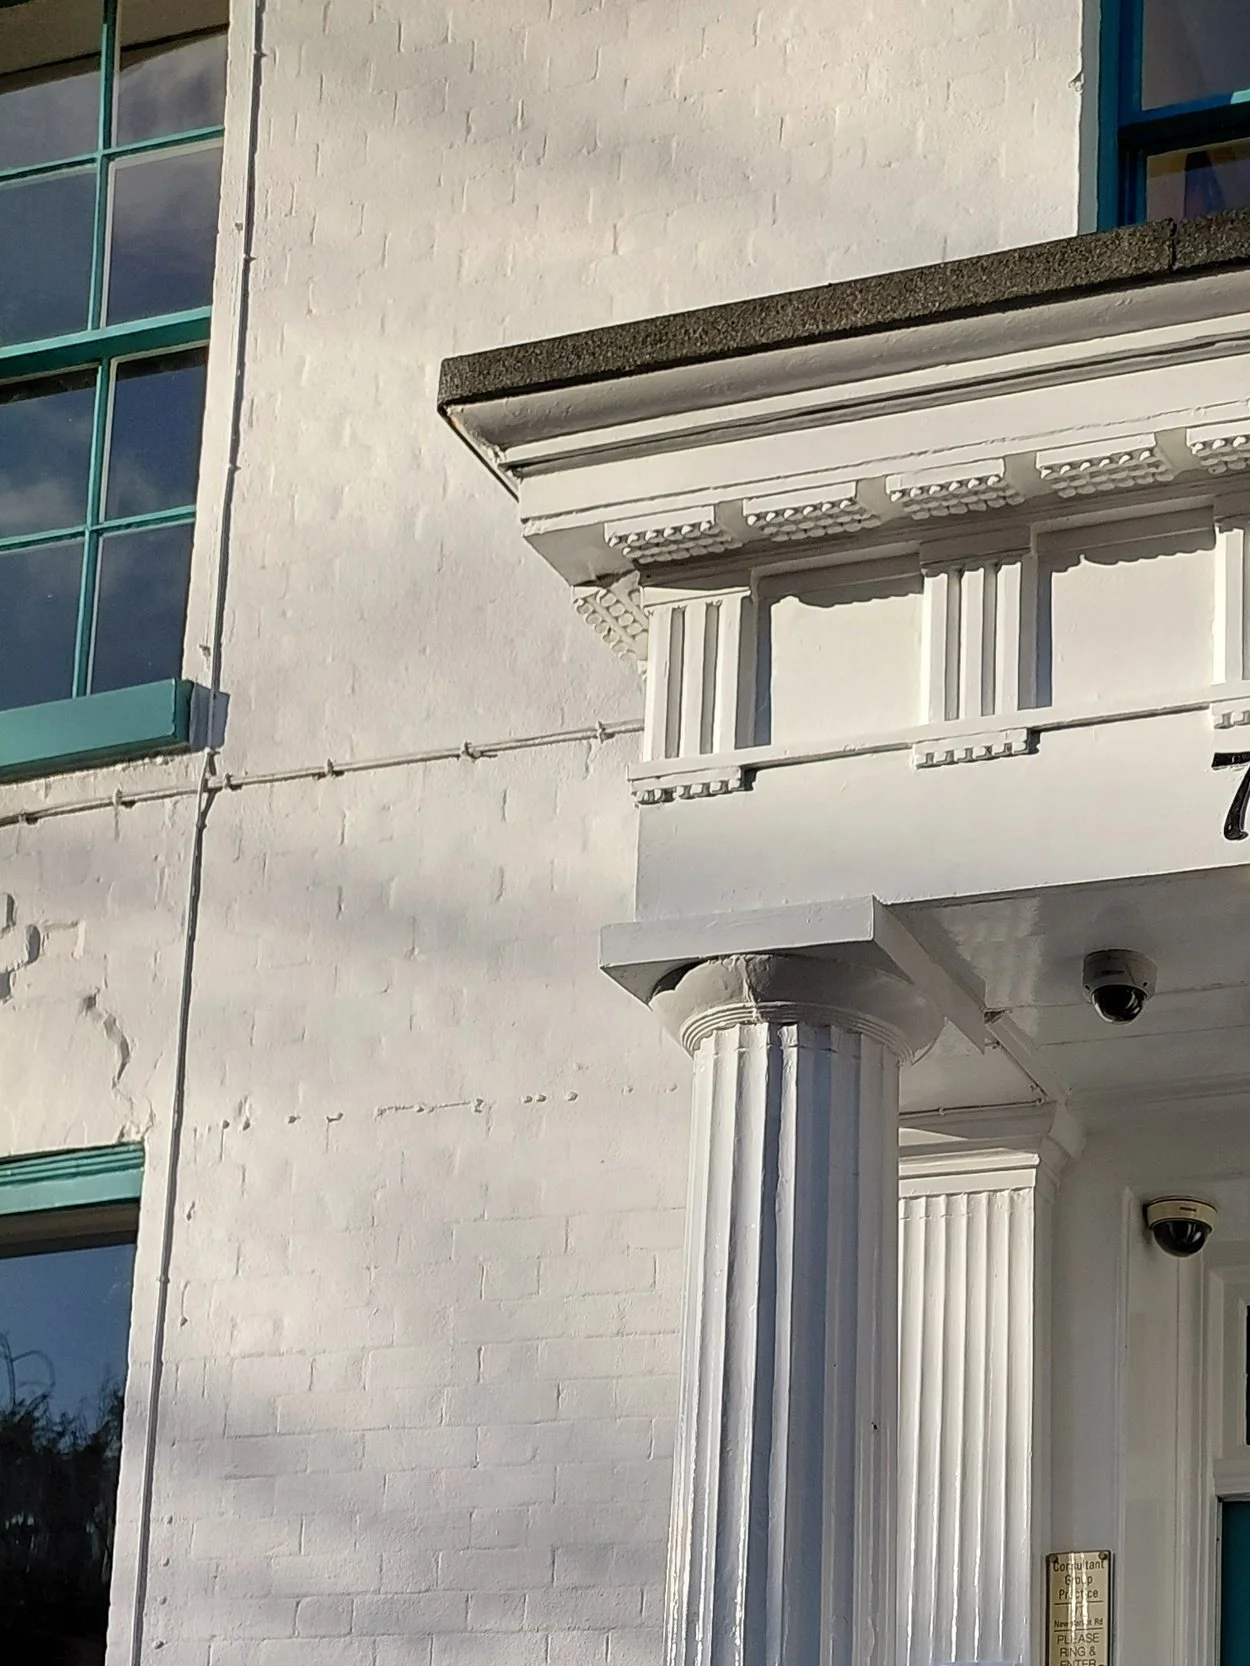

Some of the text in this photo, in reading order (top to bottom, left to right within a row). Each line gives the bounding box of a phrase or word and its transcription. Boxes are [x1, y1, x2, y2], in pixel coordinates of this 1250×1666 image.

[1053, 1560, 1104, 1572] Conutant
[1059, 1589, 1099, 1600] Prctce
[1057, 1633, 1100, 1645] PLEASE
[1089, 1646, 1096, 1657] &
